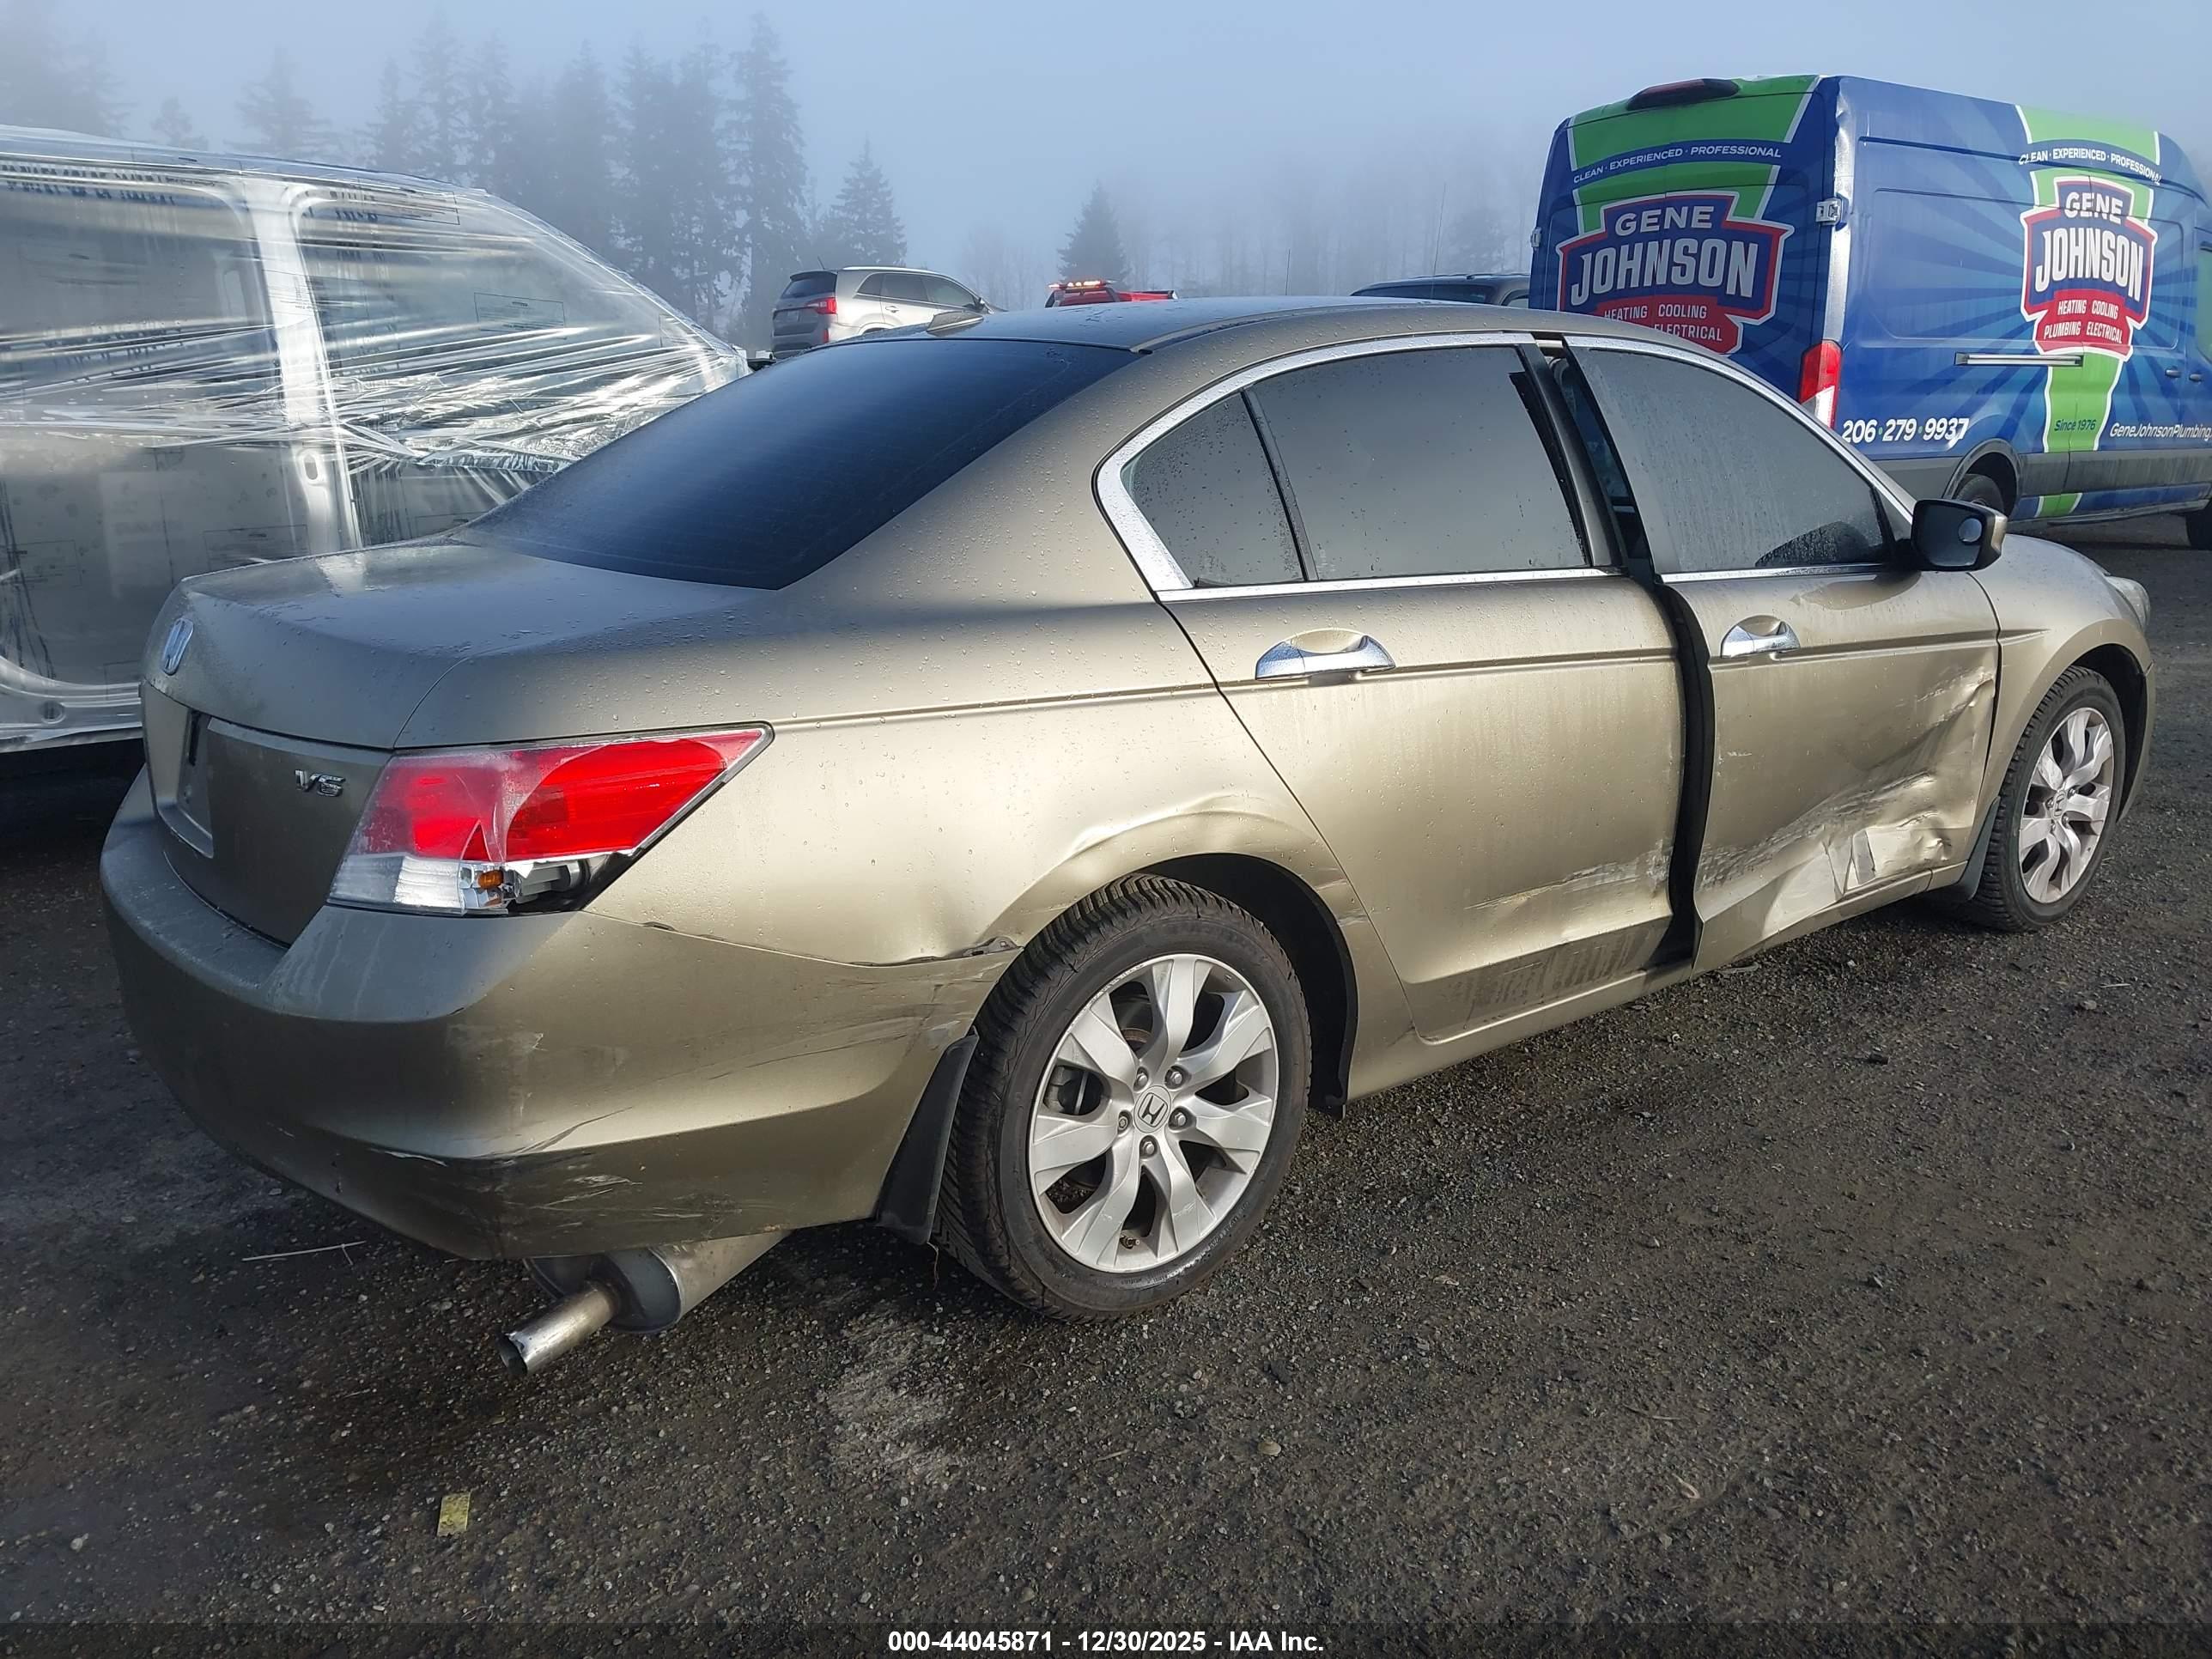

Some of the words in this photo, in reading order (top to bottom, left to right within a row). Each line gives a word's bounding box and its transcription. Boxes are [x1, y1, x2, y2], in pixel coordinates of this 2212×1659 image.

[1573, 166, 1603, 183] CLEAN
[1609, 149, 1683, 171] EXPERIENCED
[1690, 145, 1782, 158] PROFESSIONAL
[2018, 149, 2049, 166] CLEAN
[2052, 148, 2106, 161] EXPERIENCED
[2110, 153, 2162, 185] PROFESSIONAL
[1614, 205, 1715, 236] GENE
[2063, 191, 2124, 225] GENE
[1570, 238, 1759, 307] JOHNSON
[2034, 226, 2145, 302] JOHNSON
[1658, 303, 1707, 319] COOLING
[2057, 300, 2087, 316] HEATING
[2091, 300, 2119, 320] COOLING
[2044, 320, 2082, 340] PLUMBING
[2086, 320, 2124, 344] ELECTRICAL
[1842, 419, 1878, 444] 206
[1882, 418, 1917, 442] 279
[1923, 417, 1970, 441] 9937
[2054, 418, 2076, 431] Since
[2077, 419, 2097, 430] 1976
